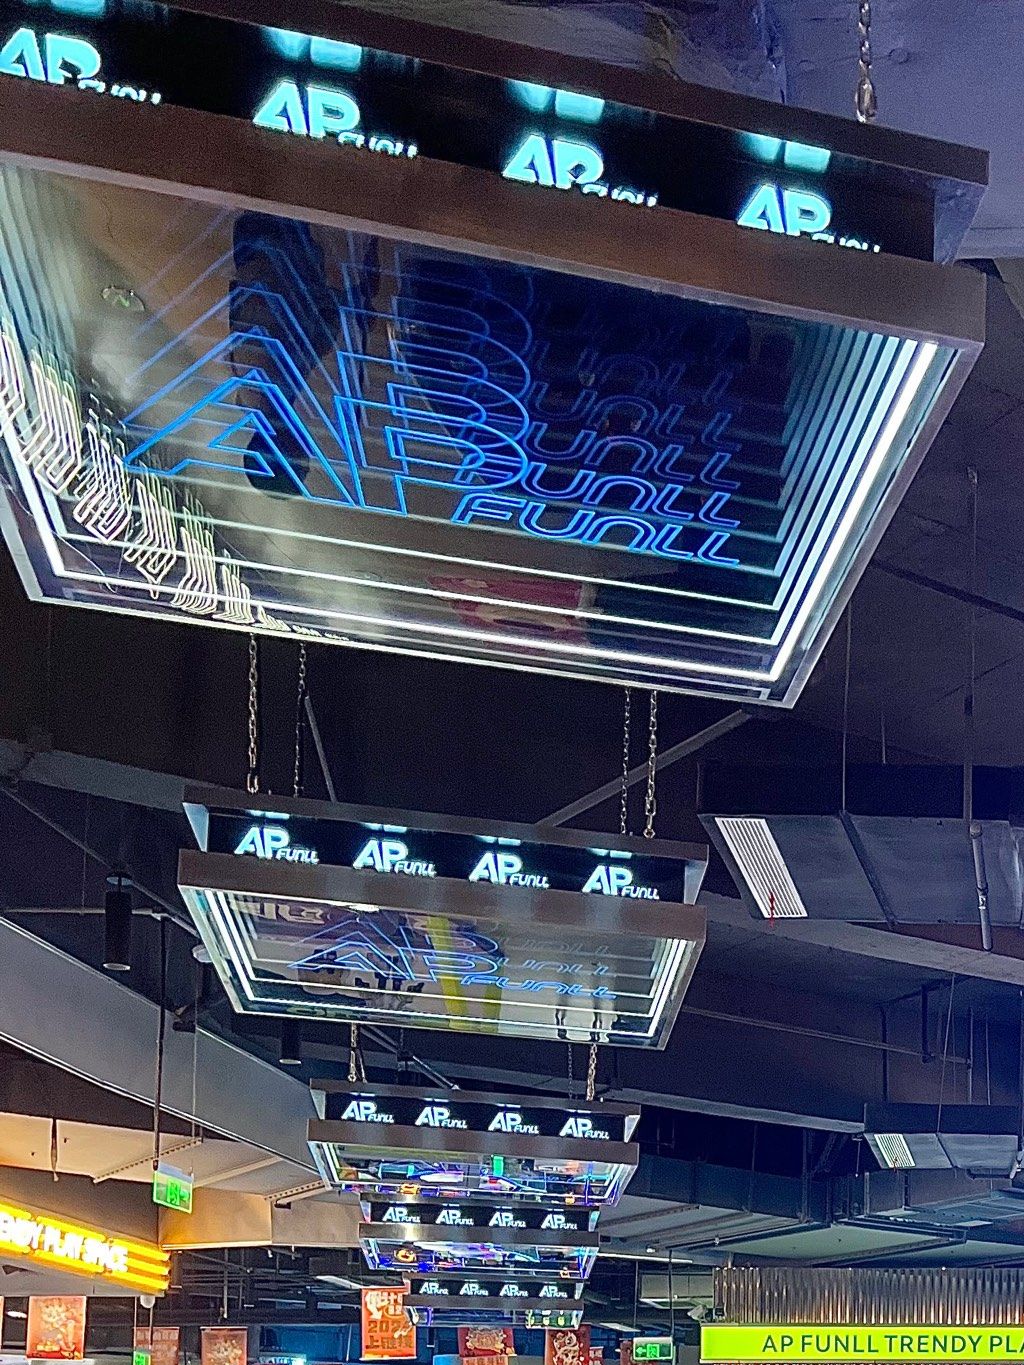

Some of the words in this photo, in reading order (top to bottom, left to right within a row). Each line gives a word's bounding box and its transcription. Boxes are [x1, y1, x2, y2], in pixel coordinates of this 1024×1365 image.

[0, 27, 101, 85] AP
[252, 80, 361, 139] AP
[502, 133, 604, 190] AP
[736, 183, 832, 237] AP
[234, 826, 290, 860] AP
[353, 839, 409, 873] AP
[468, 852, 523, 885] AP
[581, 865, 634, 897] AP
[341, 1101, 376, 1122] AP
[415, 1106, 449, 1128] AP
[488, 1112, 522, 1133] AP
[559, 1117, 592, 1138] AP
[763, 1334, 794, 1353] AP
[801, 1334, 879, 1353] FUNLL
[884, 1334, 983, 1354] TRENDY
